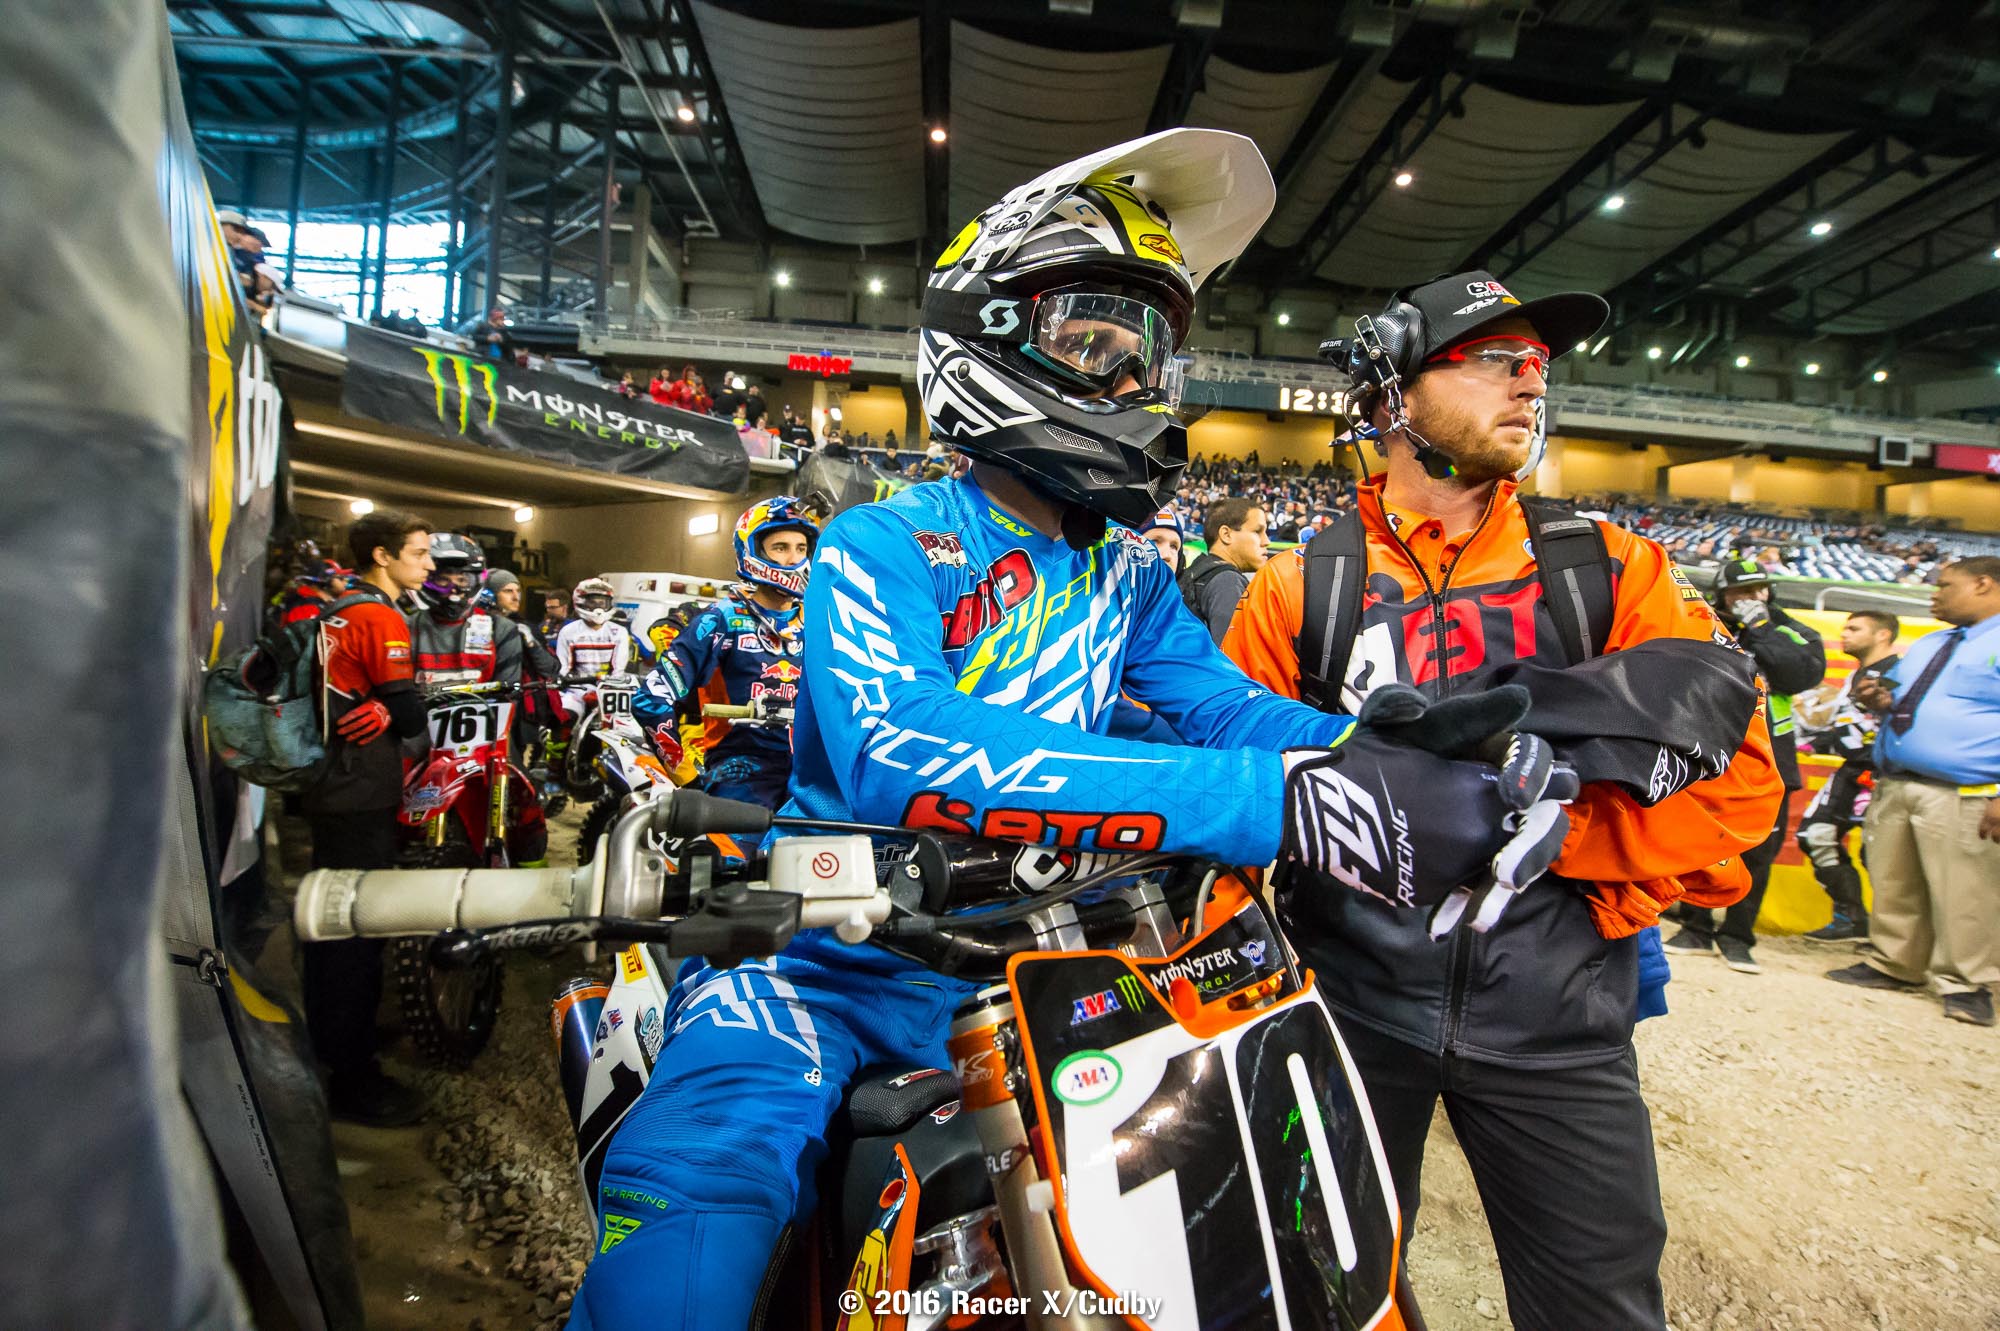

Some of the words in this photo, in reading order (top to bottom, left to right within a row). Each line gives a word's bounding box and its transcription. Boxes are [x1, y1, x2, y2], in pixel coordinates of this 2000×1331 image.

[788, 351, 853, 378] meijer
[1280, 387, 1361, 415] 12:3
[507, 385, 703, 446] MONSTER
[544, 412, 681, 451] ENERGY
[769, 568, 800, 592] Bull
[603, 692, 632, 714] 80
[1395, 808, 1416, 908] RACING
[1070, 989, 1122, 1026] AMA
[1071, 1066, 1110, 1092] AMA
[619, 1189, 669, 1210] RACING
